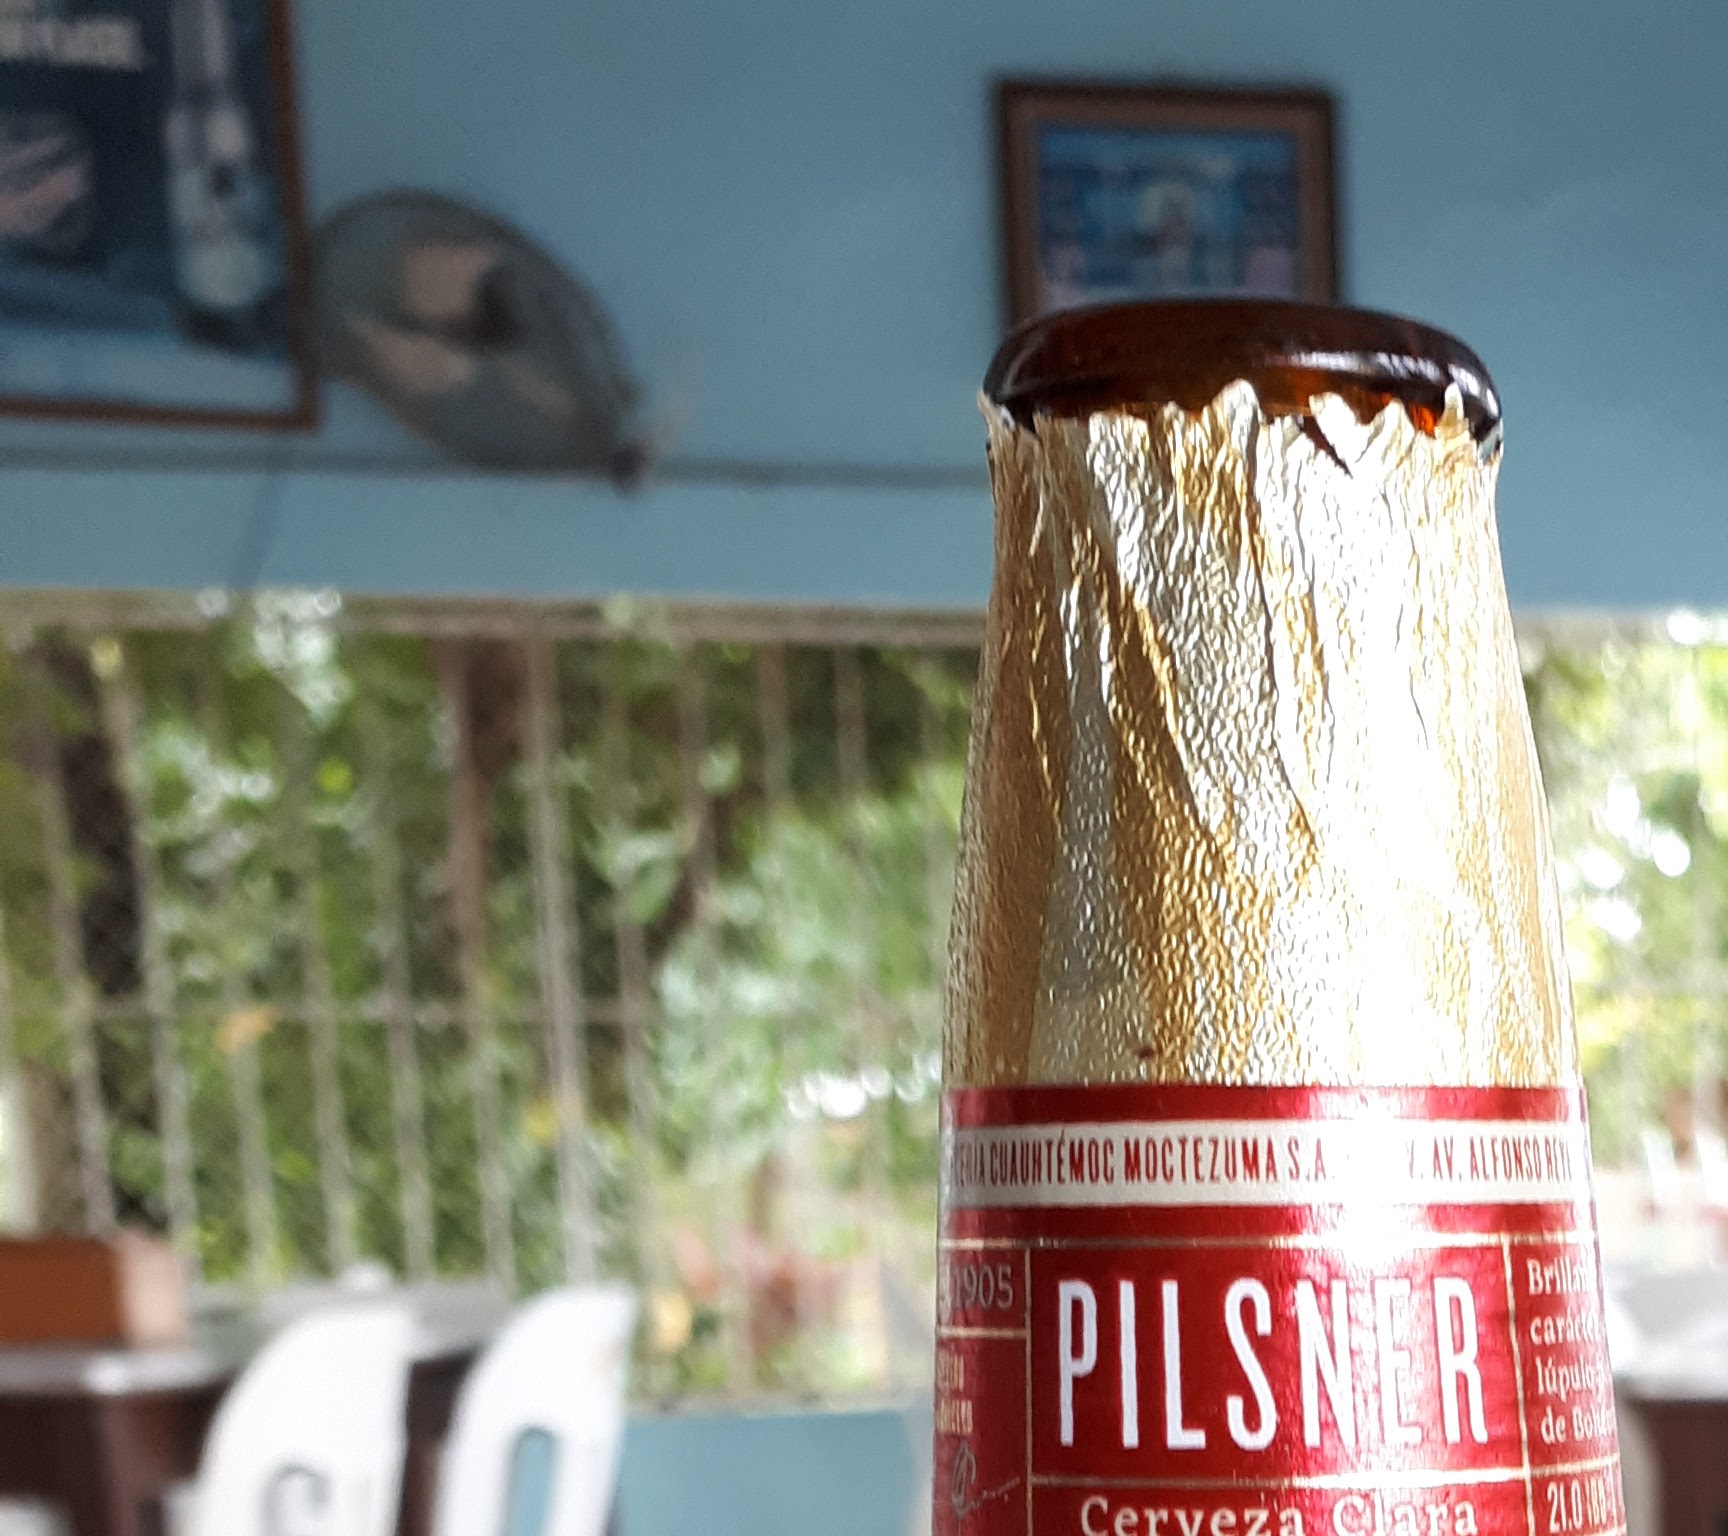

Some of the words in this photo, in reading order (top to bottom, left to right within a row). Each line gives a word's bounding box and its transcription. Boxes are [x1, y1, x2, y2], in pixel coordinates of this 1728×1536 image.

[989, 1128, 1115, 1187] CUAUHTÉMOC
[1123, 1132, 1278, 1185] MOCTEZUMA
[1469, 1135, 1543, 1184] ALFONSO
[1058, 1276, 1489, 1452] PILSNER
[1535, 1354, 1593, 1404] lúpulo
[1540, 1404, 1567, 1447] de
[1546, 1476, 1585, 1535] 21.0
